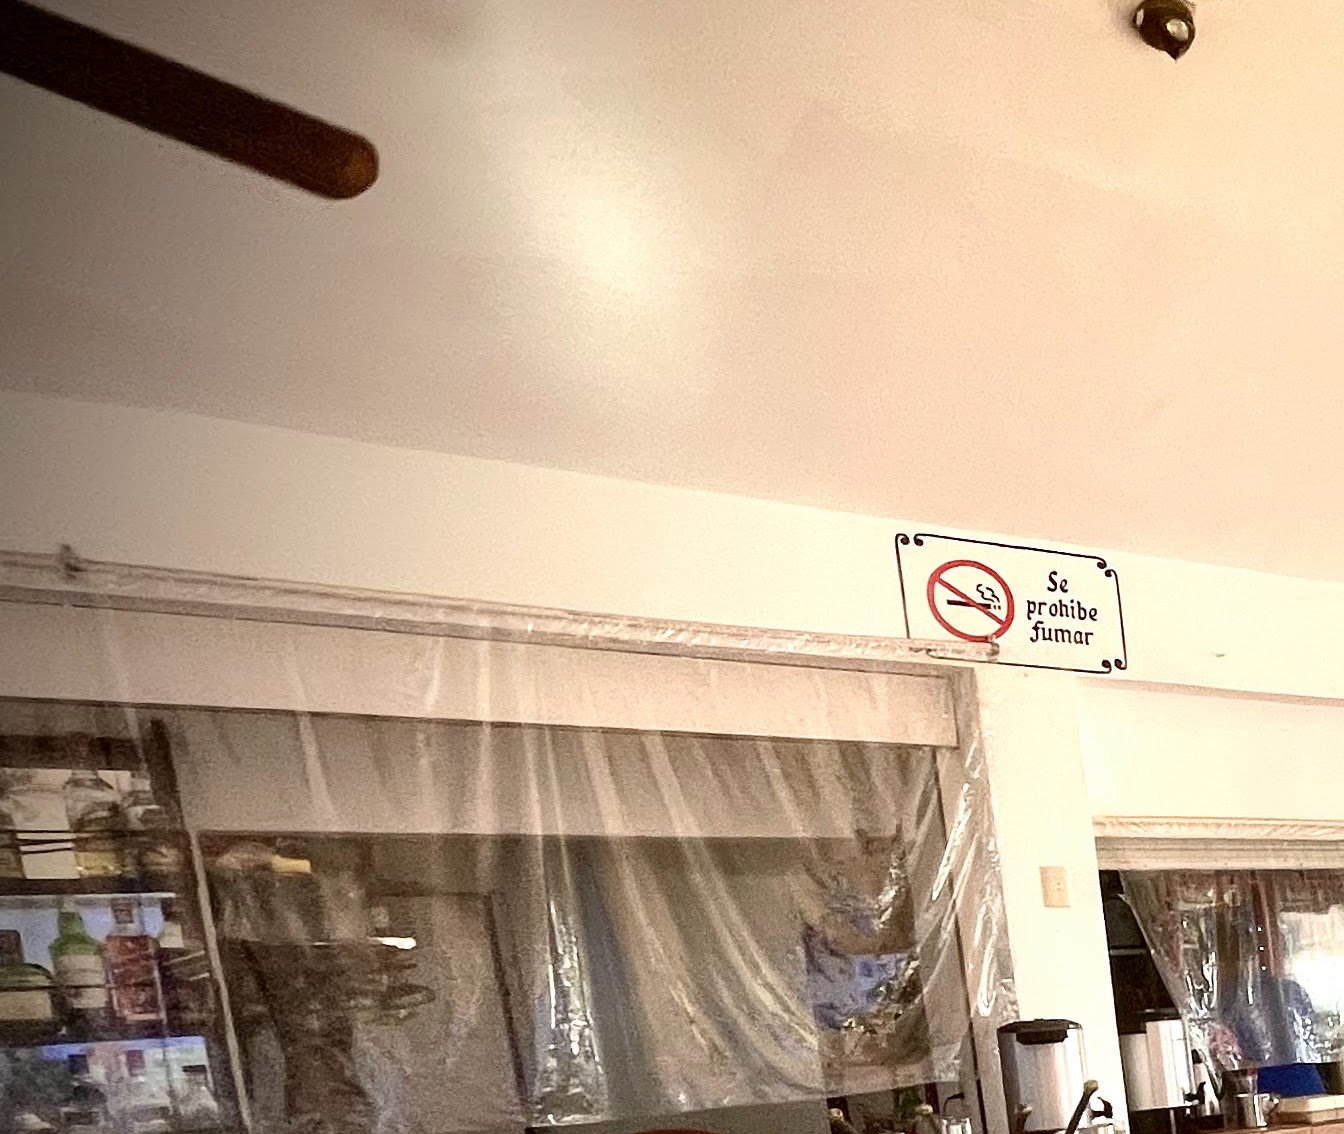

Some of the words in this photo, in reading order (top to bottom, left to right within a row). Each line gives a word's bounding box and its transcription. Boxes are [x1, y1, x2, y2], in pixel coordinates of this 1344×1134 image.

[1047, 570, 1069, 593] Se
[1026, 599, 1098, 621] prohibe
[1029, 621, 1094, 646] fumar
